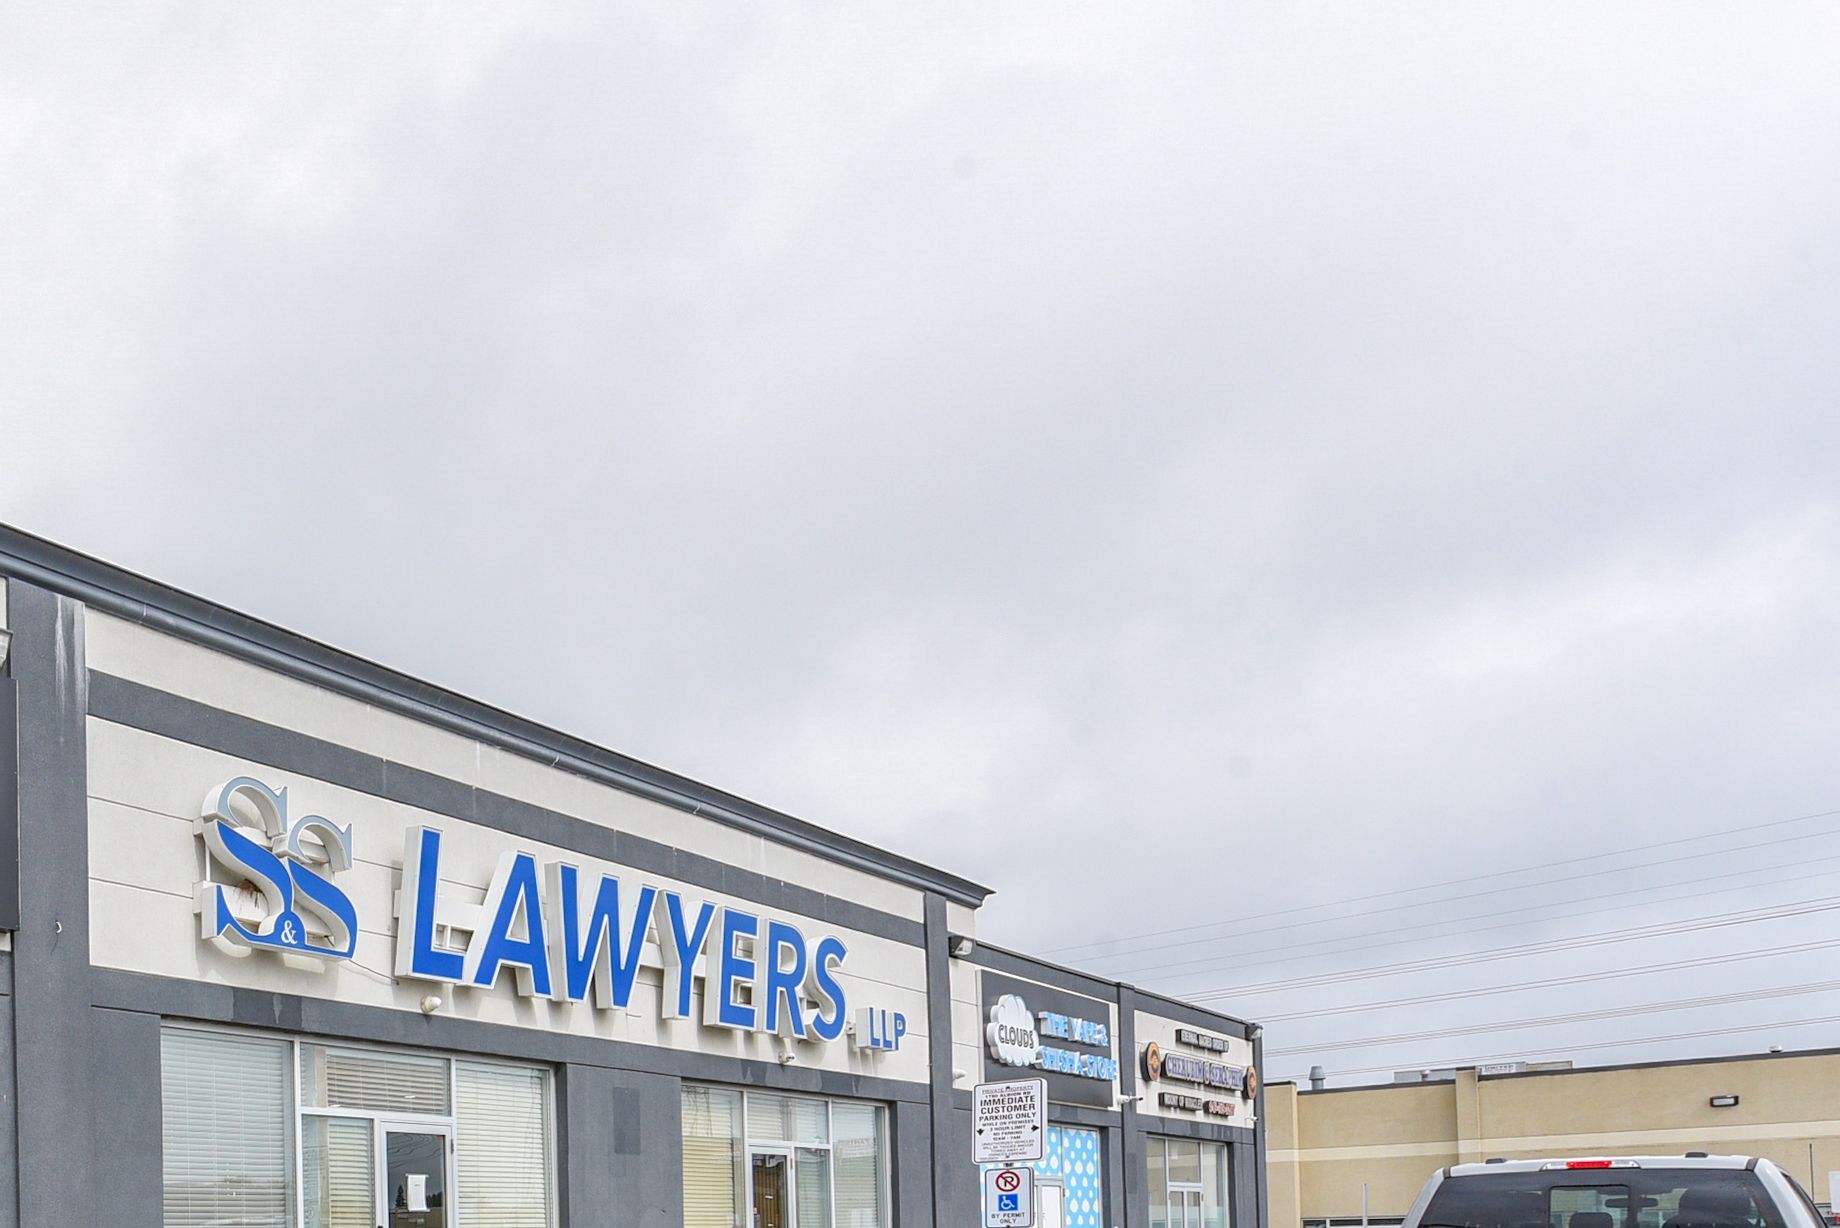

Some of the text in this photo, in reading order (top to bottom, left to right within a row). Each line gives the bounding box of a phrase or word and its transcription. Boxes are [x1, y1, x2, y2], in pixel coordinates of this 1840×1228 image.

[400, 824, 907, 1051] LAWYERS LLP
[1040, 1011, 1069, 1039] THE
[998, 1024, 1035, 1050] CLOUDS
[980, 1095, 1035, 1106] IMMEDIATE
[980, 1103, 1035, 1115] CUSTOMER
[979, 1113, 1013, 1122] PARKING
